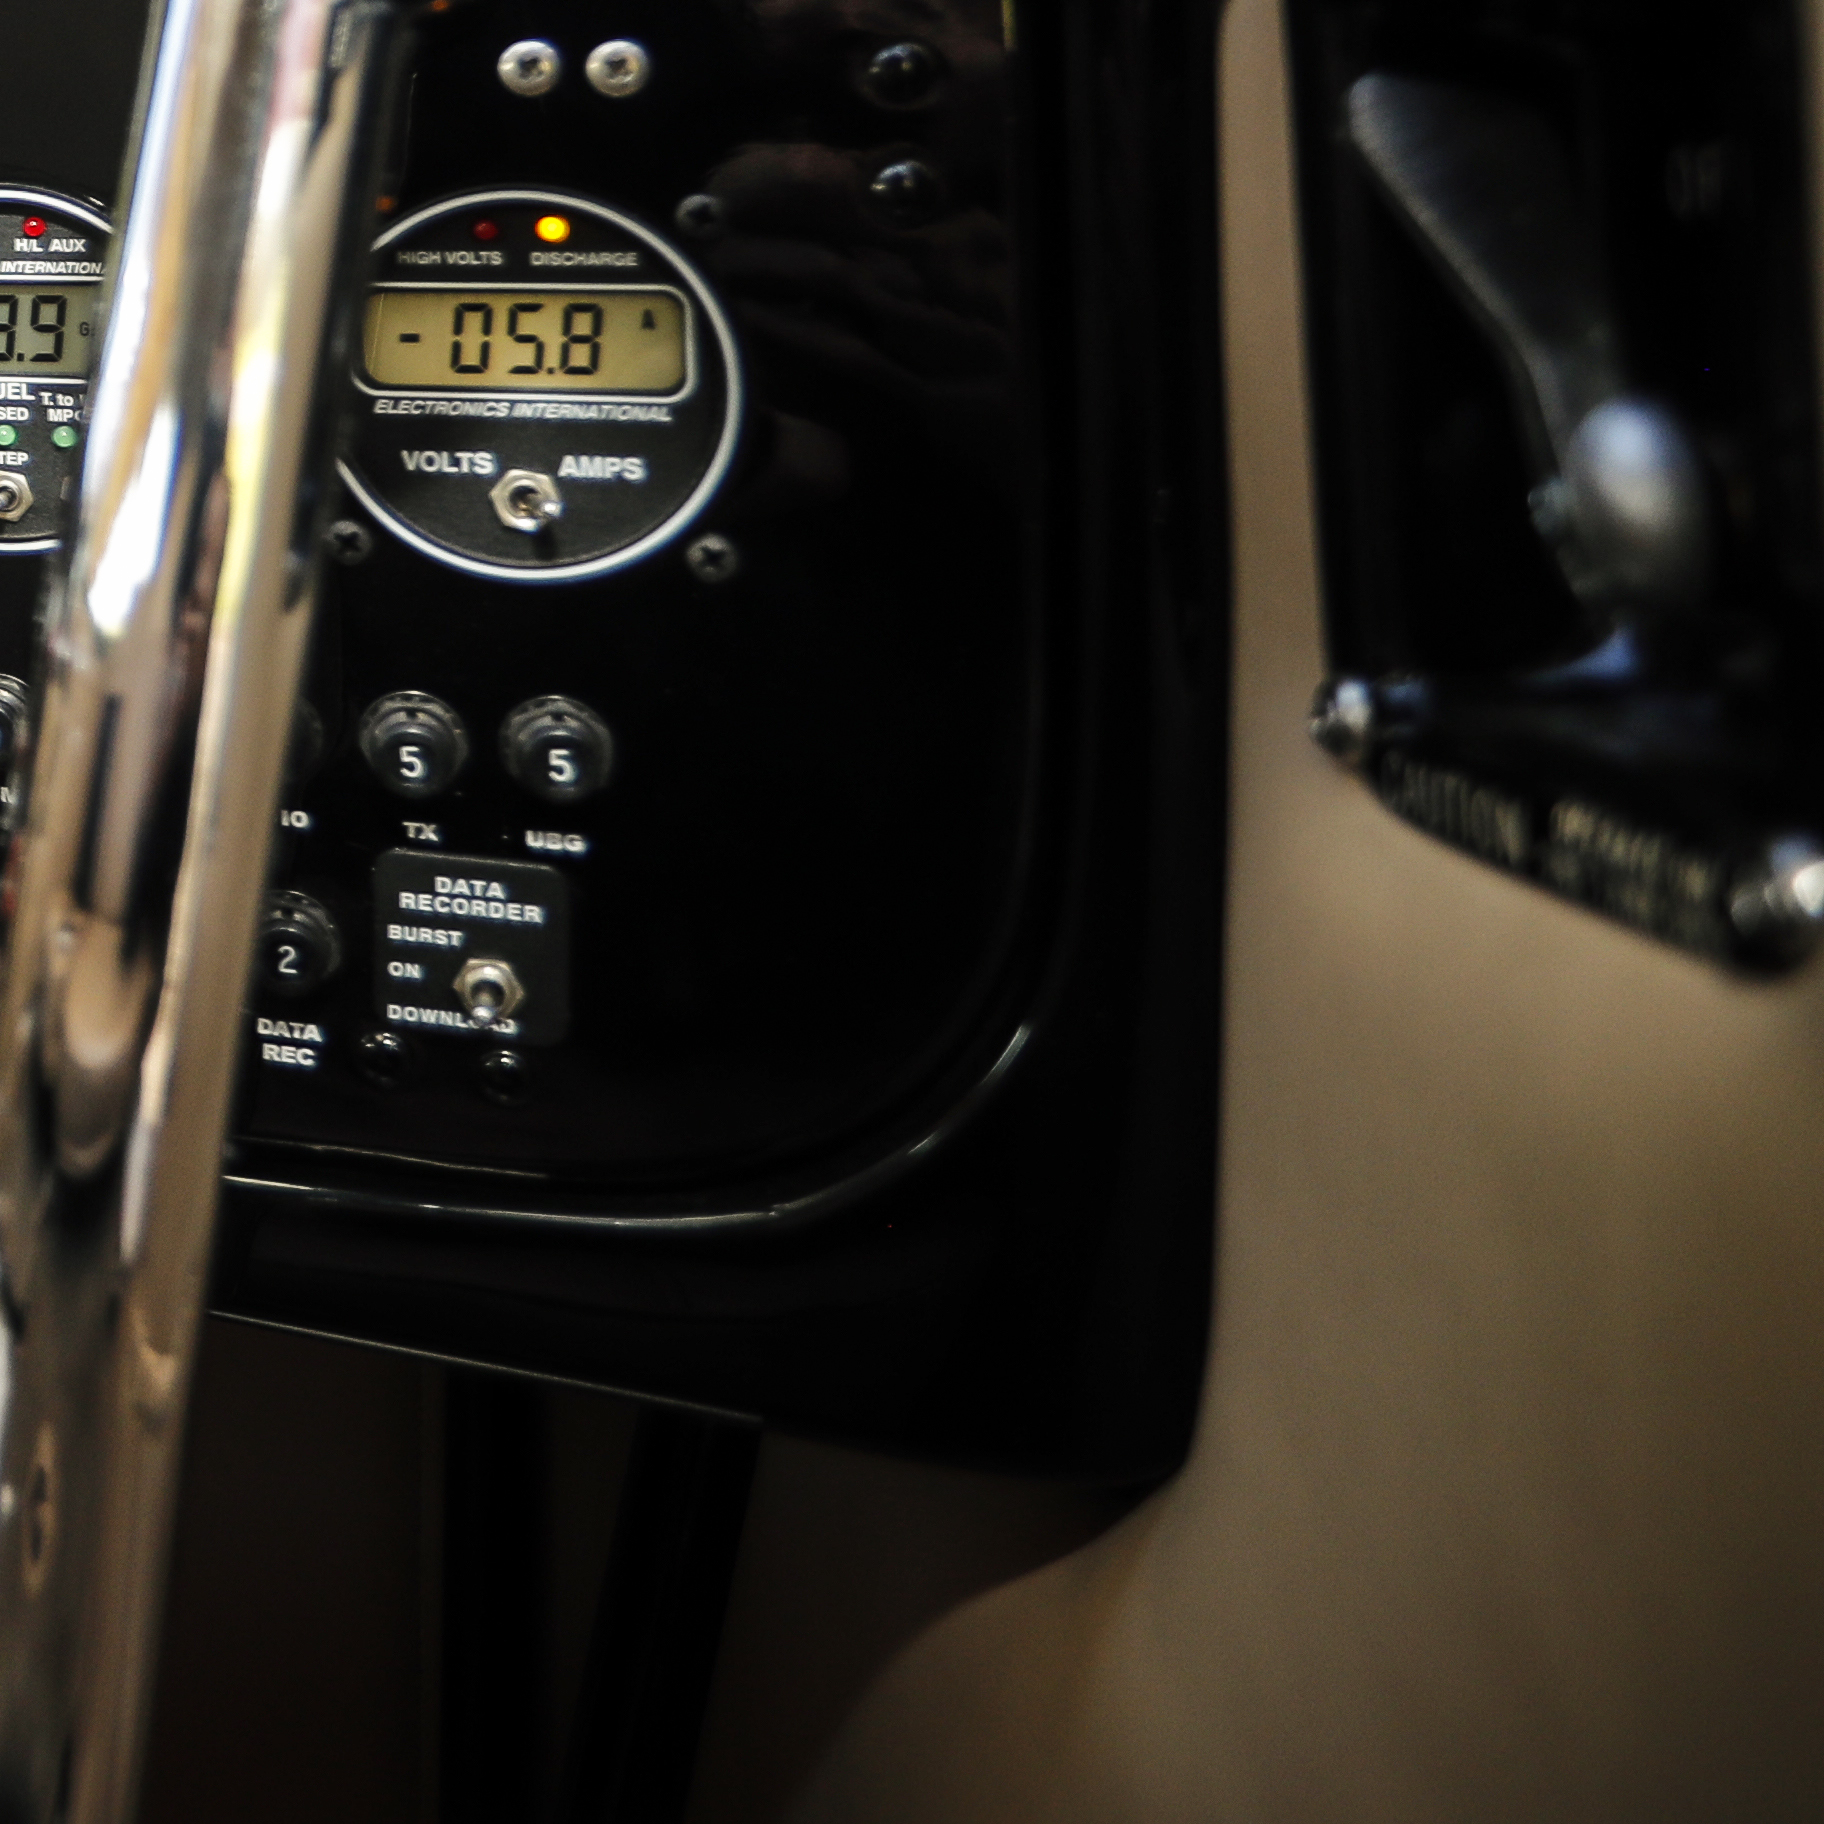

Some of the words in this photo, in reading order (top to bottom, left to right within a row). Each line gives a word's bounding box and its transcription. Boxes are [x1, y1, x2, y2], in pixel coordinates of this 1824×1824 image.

[15, 238, 43, 252] H/L
[49, 238, 86, 252] AUX
[0, 260, 104, 274] INTERNATION
[530, 251, 638, 267] DISCHARGE
[374, 399, 510, 418] ELECTRONICS
[513, 403, 672, 422] INTERNATIONAL
[401, 450, 497, 473] VOLTS
[558, 455, 646, 479] AMPS
[403, 822, 439, 843] TX
[433, 875, 506, 900] DATA
[398, 891, 543, 924] RECORDER
[387, 924, 463, 948] BURST
[387, 961, 421, 979] ON
[258, 1018, 322, 1043] DATA
[262, 1044, 316, 1067] REC
